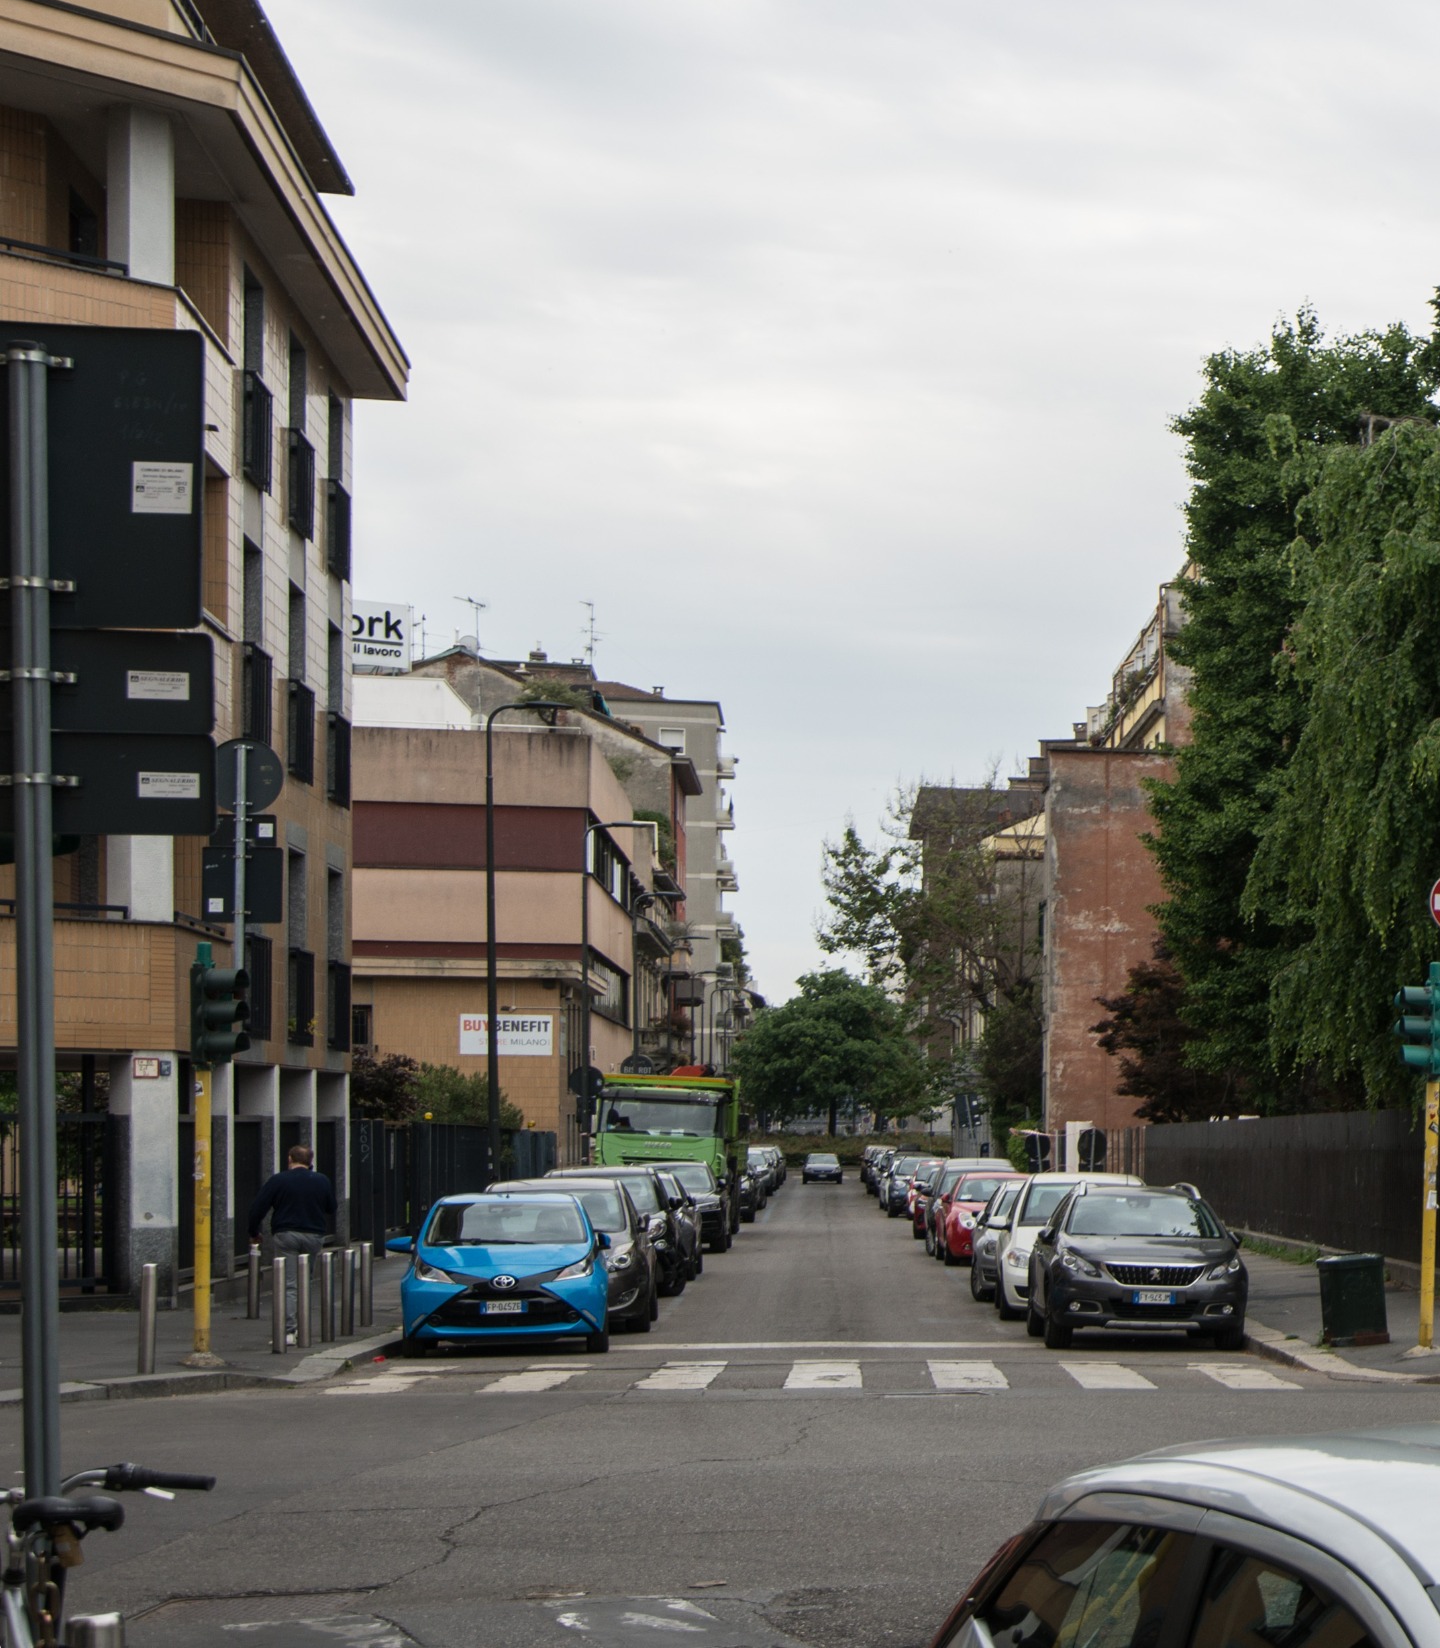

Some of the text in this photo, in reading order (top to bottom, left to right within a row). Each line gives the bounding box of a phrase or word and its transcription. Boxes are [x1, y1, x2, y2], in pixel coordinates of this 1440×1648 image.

[353, 643, 402, 658] il lavoro
[479, 1038, 508, 1046] STRE
